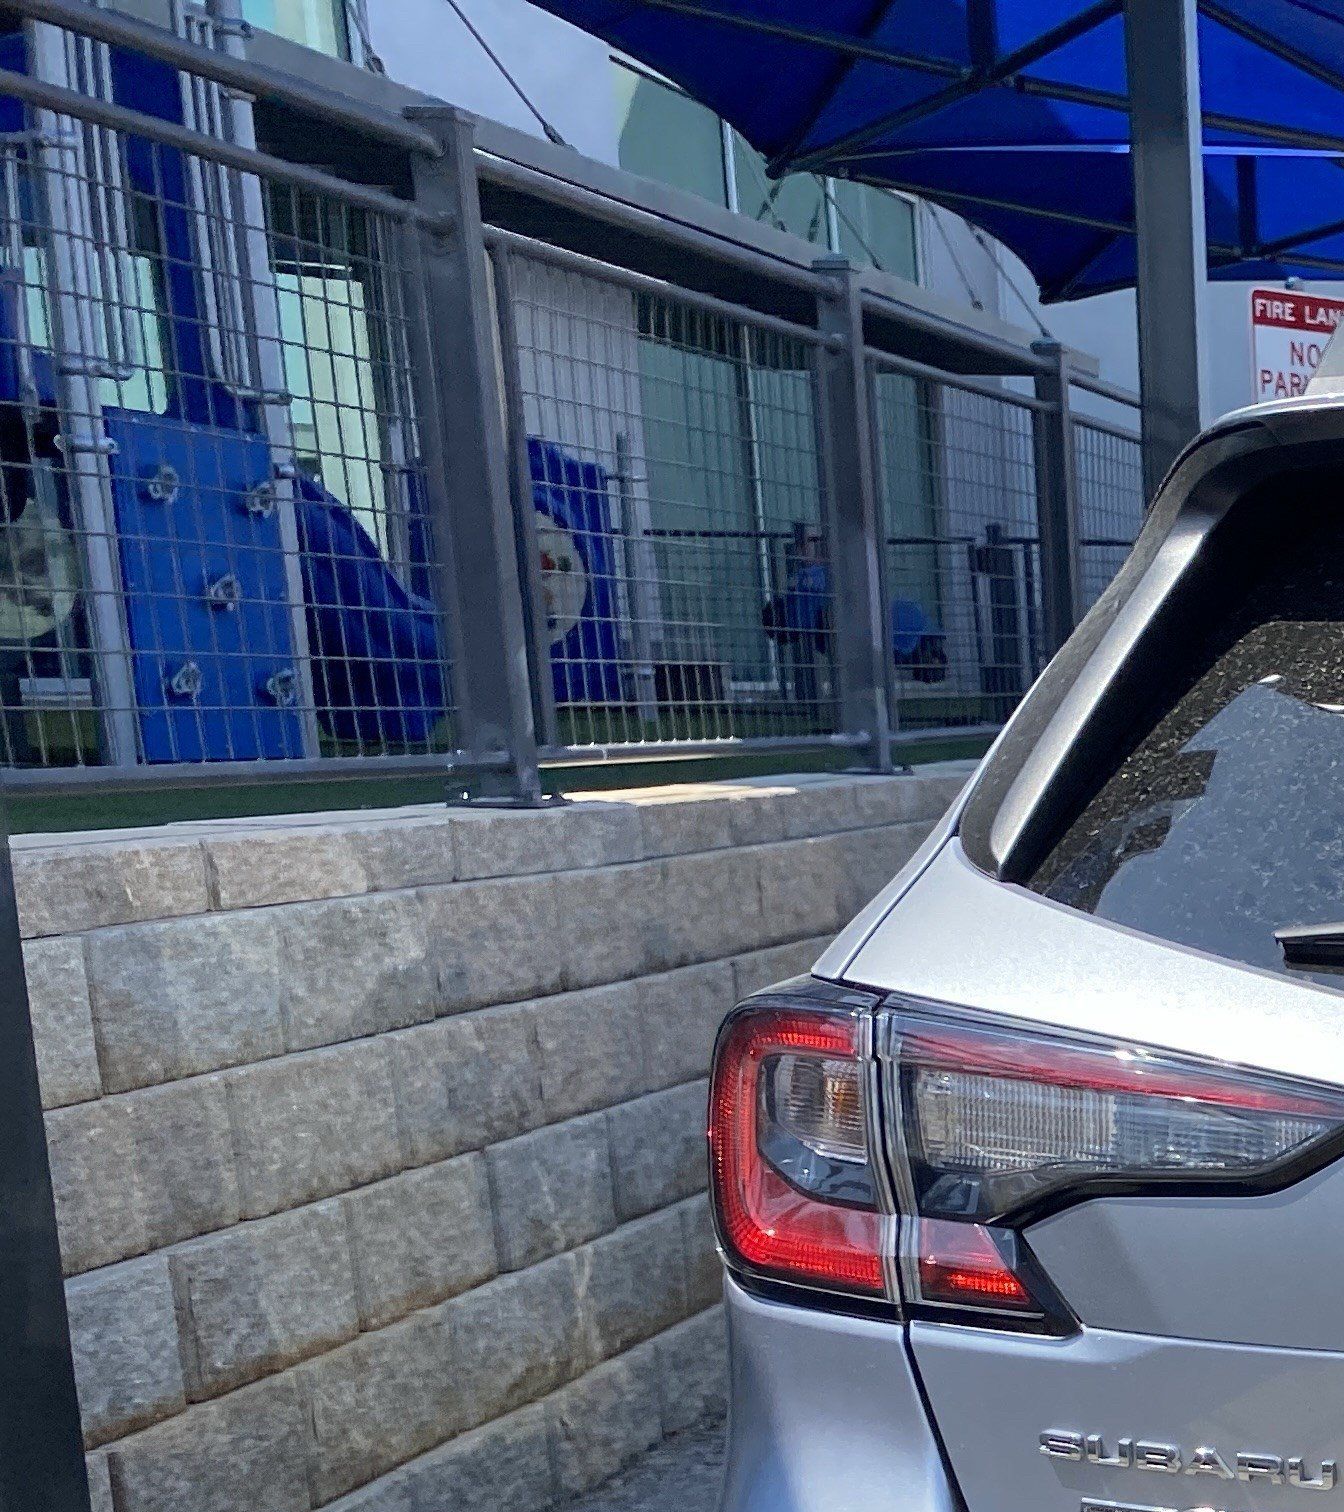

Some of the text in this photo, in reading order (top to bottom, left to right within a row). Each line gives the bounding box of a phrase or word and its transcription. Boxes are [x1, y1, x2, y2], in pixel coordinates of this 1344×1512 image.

[1254, 299, 1344, 326] FIRE LAN
[1289, 341, 1322, 368] NO
[1039, 1428, 1338, 1491] SUBARU
